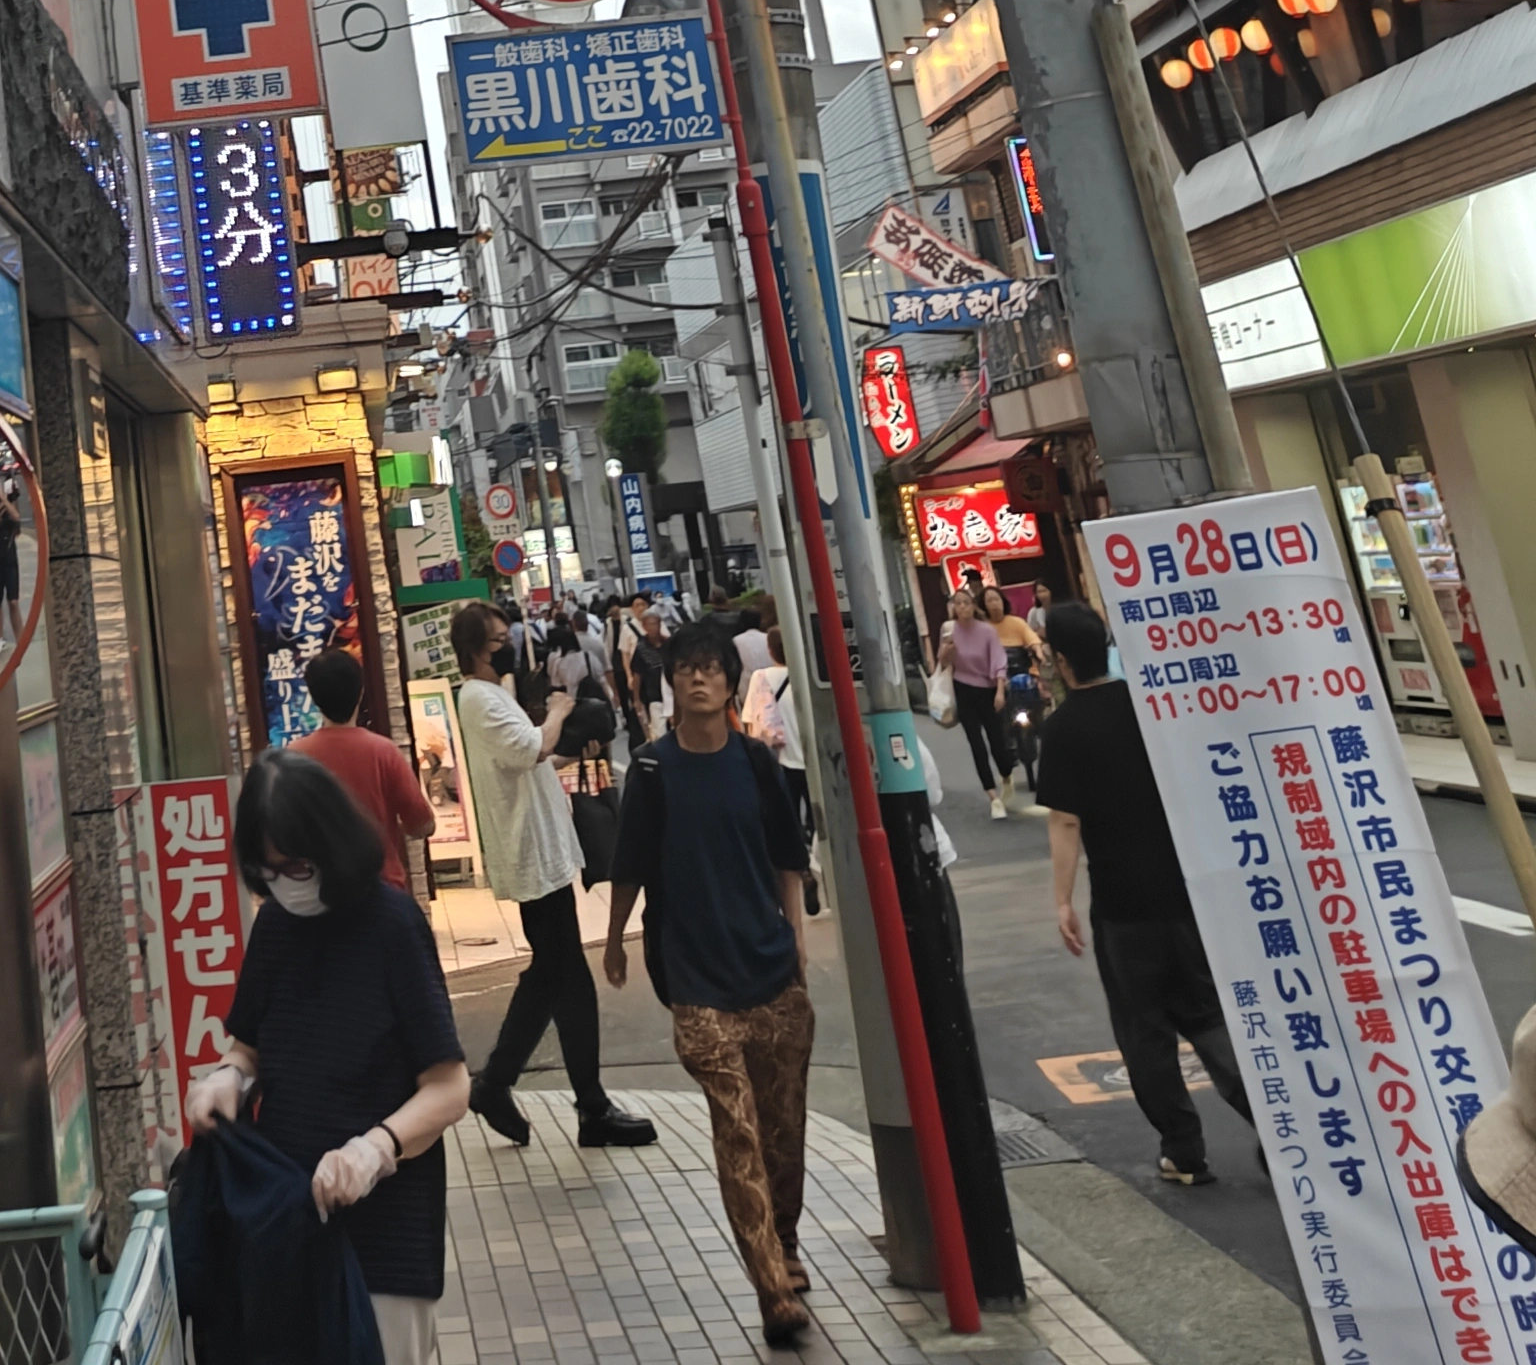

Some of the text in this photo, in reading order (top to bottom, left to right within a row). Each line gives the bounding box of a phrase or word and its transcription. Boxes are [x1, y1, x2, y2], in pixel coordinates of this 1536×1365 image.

[469, 25, 686, 68] 一般歯科・矯正歯科
[180, 73, 285, 106] 基準薬局
[466, 50, 707, 136] 黒川歯科
[567, 125, 607, 150] ここ
[875, 352, 913, 454] ラーメン
[492, 493, 511, 510] 30
[621, 478, 650, 552] 山内病院
[1118, 588, 1221, 624] 南口周辺
[1139, 653, 1241, 689] 北口周辺
[161, 793, 237, 1084] 処方せん
[1207, 741, 1366, 1197] ご協力お願い致します
